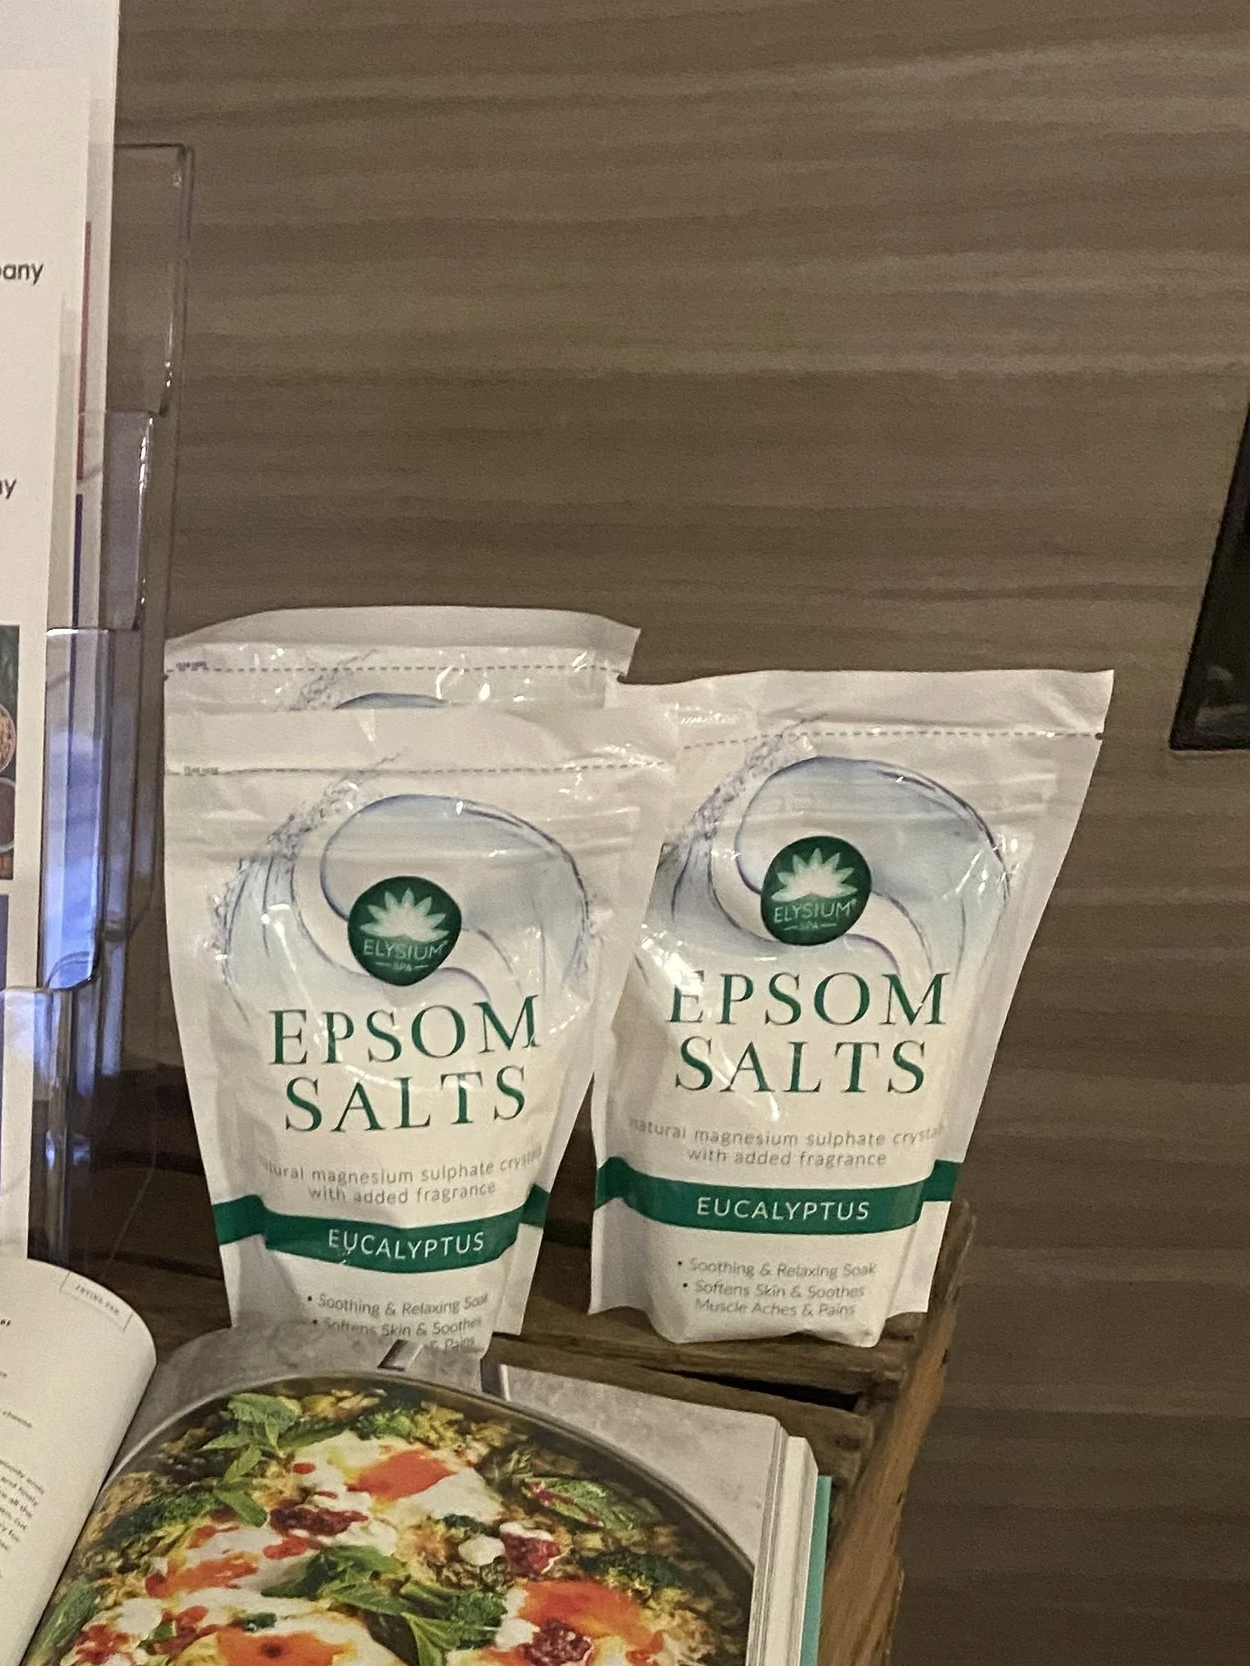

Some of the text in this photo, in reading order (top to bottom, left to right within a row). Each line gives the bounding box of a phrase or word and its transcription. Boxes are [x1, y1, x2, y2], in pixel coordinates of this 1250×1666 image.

[774, 901, 850, 923] ELYSIUM
[363, 939, 445, 960] ELYSIUM
[666, 970, 951, 1026] EPSOM
[268, 994, 541, 1065] EPSOM
[674, 1035, 926, 1094] SALTS
[285, 1064, 526, 1133] SALTS
[629, 1117, 686, 1139] natural
[694, 1128, 797, 1147] magnesium
[806, 1131, 885, 1149] sulphate
[688, 1149, 886, 1168] with added fragrance
[312, 1167, 413, 1186] magnesium
[420, 1161, 494, 1180] sulphate
[308, 1181, 496, 1204] with added fragrance
[696, 1196, 870, 1221] EUCALYPTUS
[328, 1228, 484, 1260] EUCALYPTUS
[689, 1257, 876, 1280] Soothing & Relaxing Soak
[695, 1279, 865, 1298] Softens Skin & Soothes
[318, 1293, 459, 1317] Soothing & Relaxing
[695, 1299, 855, 1317] Muscle Aches & Pains
[381, 1323, 410, 1337] Skin
[416, 1322, 427, 1335] &
